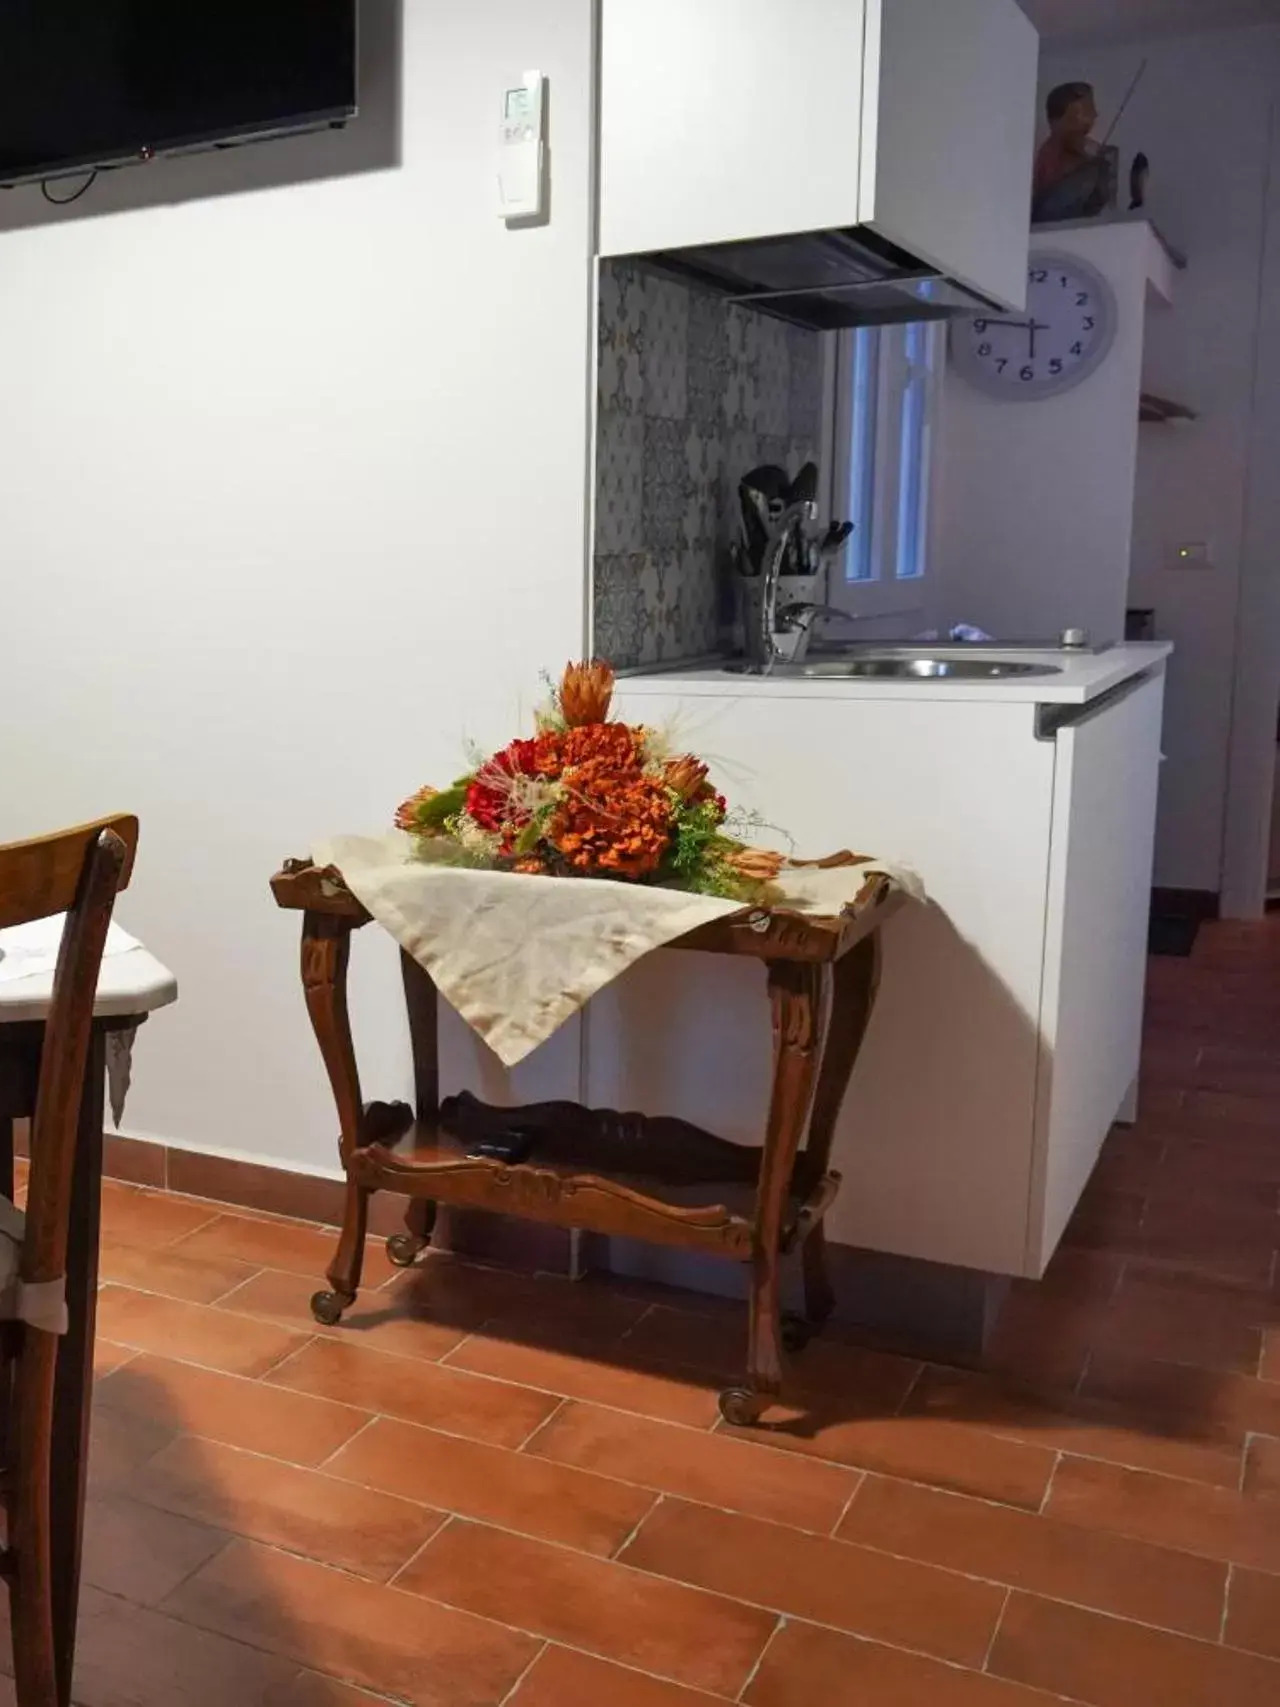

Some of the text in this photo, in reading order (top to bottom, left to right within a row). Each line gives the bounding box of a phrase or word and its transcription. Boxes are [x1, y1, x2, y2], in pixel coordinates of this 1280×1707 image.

[1060, 276, 1067, 288] 1
[1075, 292, 1088, 306] 2
[973, 318, 987, 334] 9
[1082, 316, 1095, 330] 3
[977, 342, 991, 357] 8
[1069, 340, 1082, 356] 4
[995, 358, 1008, 374] 7
[1019, 366, 1034, 381] 6
[1048, 358, 1063, 374] 5
